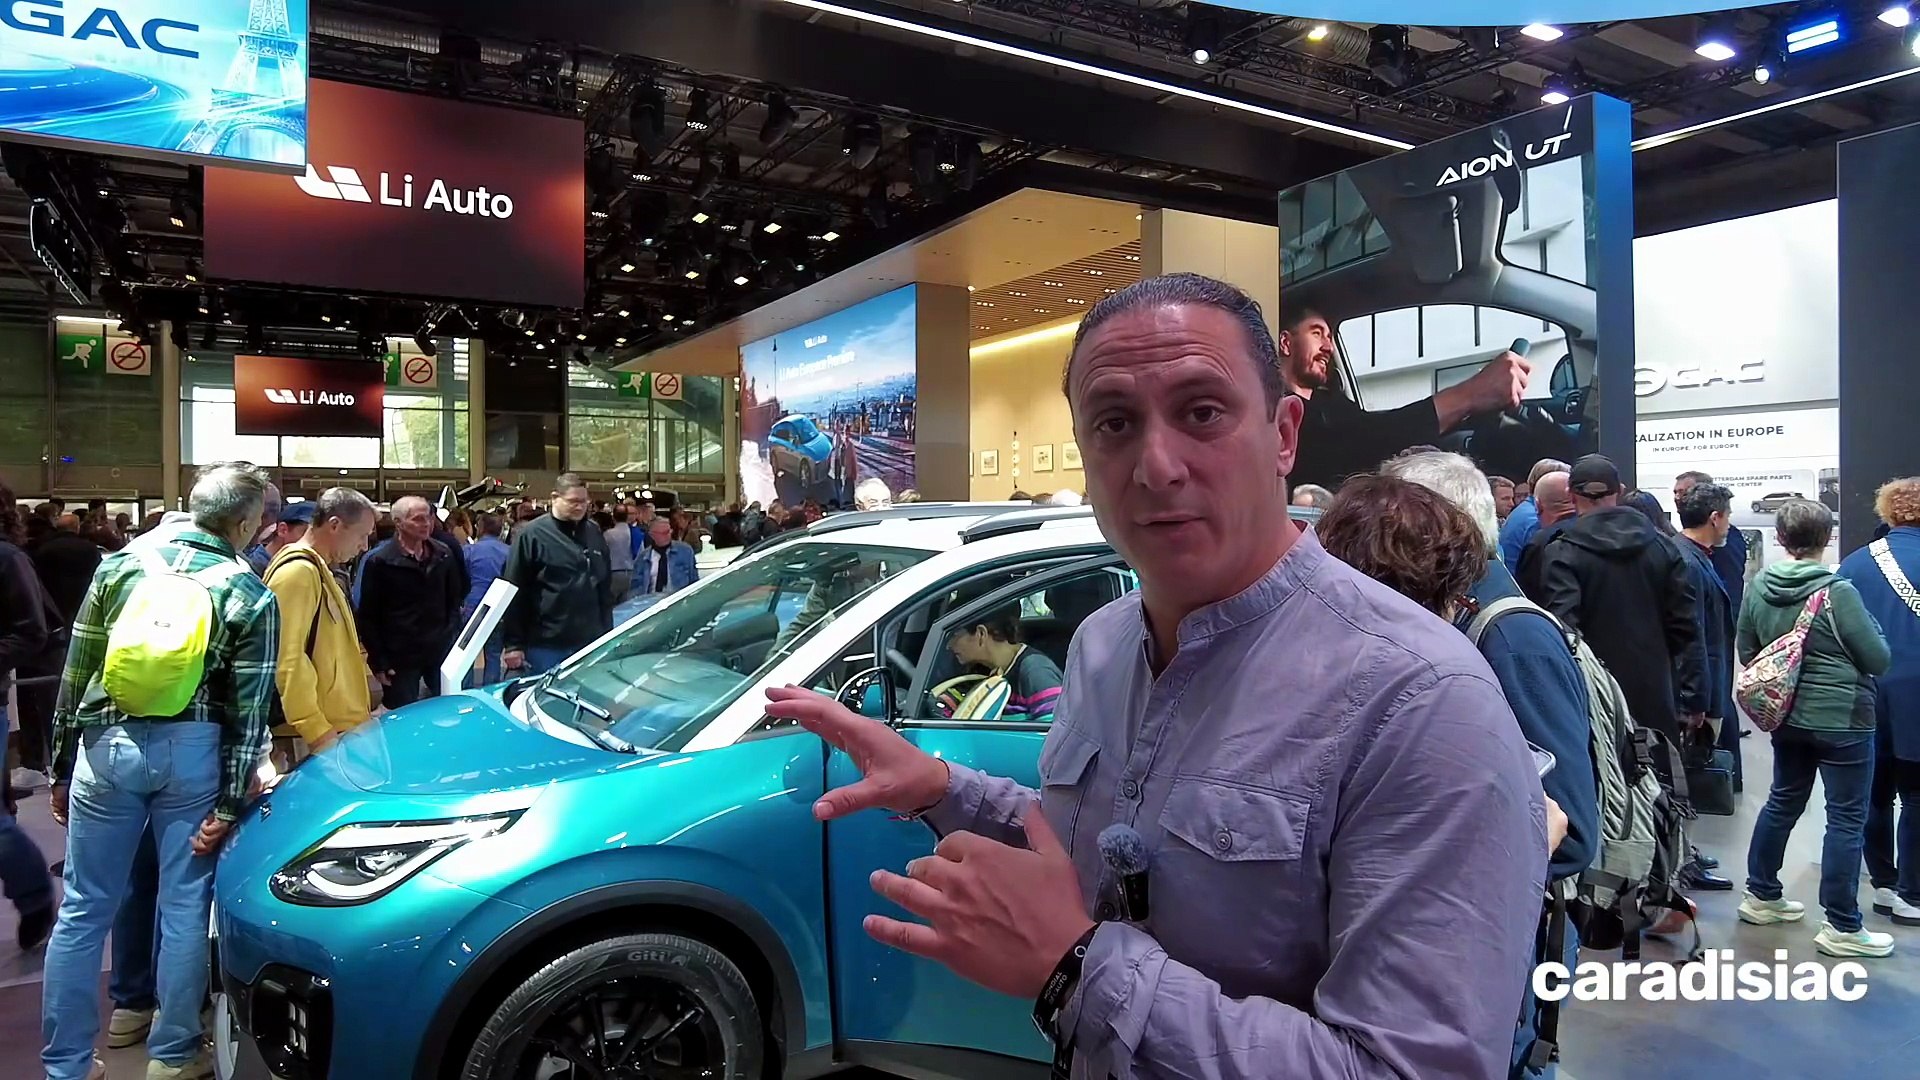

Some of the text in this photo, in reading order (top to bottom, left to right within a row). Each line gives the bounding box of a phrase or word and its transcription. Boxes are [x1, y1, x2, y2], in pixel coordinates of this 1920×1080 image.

[0, 0, 199, 59] GAC
[1436, 132, 1572, 187] AION UT
[379, 172, 514, 219] Li Auto
[300, 389, 355, 406] Li Auto
[1709, 429, 1723, 438] IN
[1727, 425, 1784, 438] EUROPE
[627, 950, 666, 962] Giti
[1043, 971, 1063, 1000] MONDIAL
